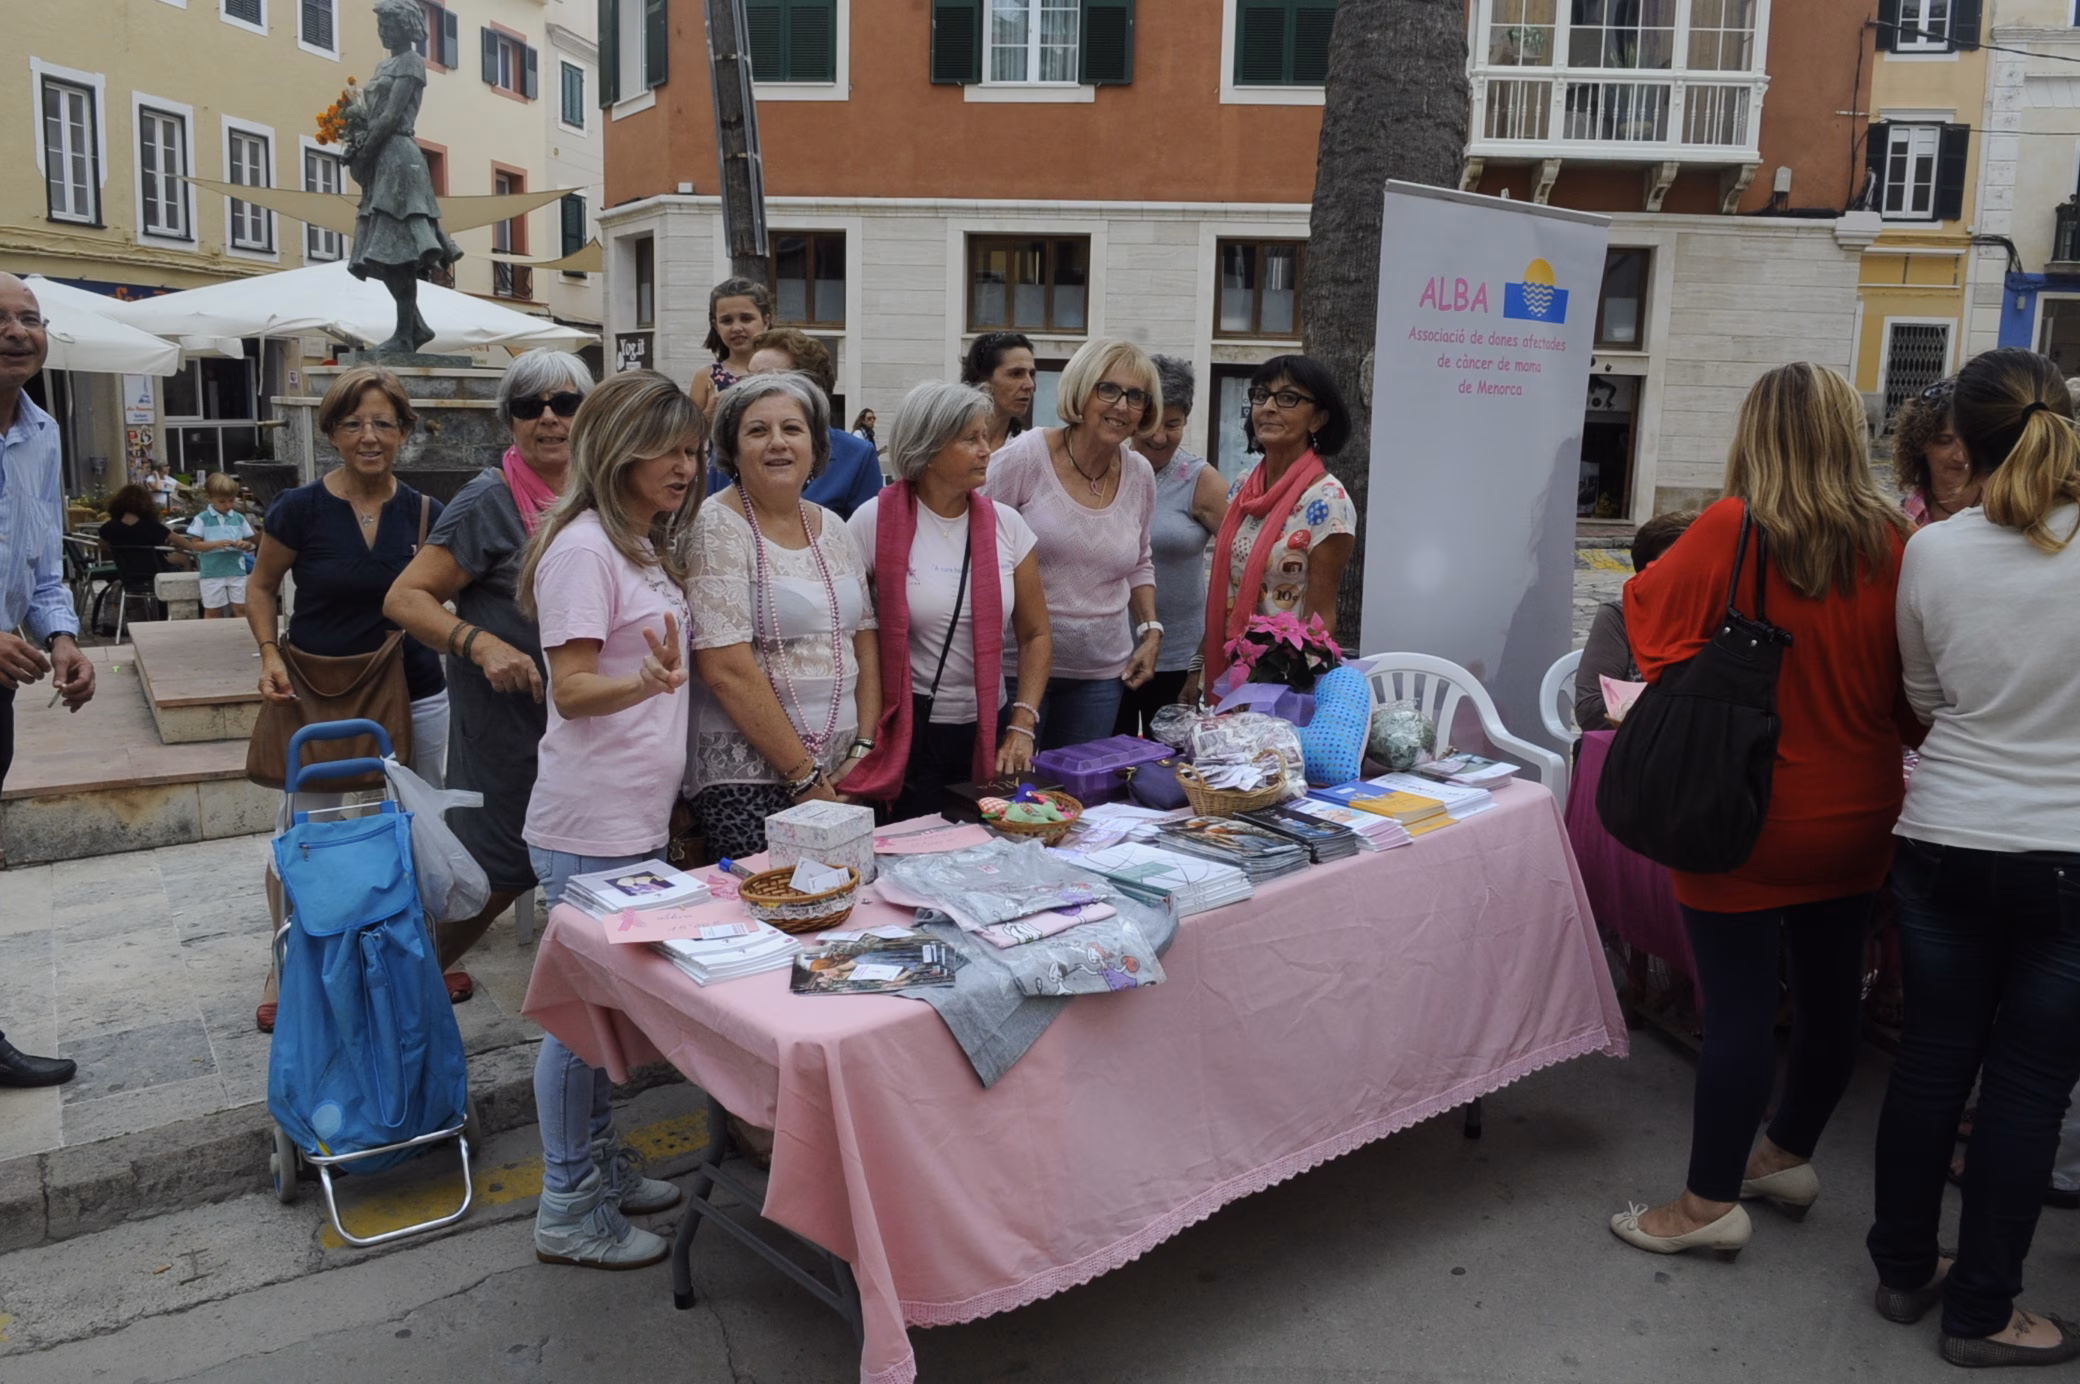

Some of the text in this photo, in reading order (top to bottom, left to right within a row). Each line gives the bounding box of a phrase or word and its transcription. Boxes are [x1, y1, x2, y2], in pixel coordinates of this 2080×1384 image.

[1419, 276, 1489, 313] ALBA
[1408, 326, 1566, 351] Associació de dones afectades
[1437, 353, 1541, 373] de càncer de mama
[1458, 379, 1522, 396] de Menorca
